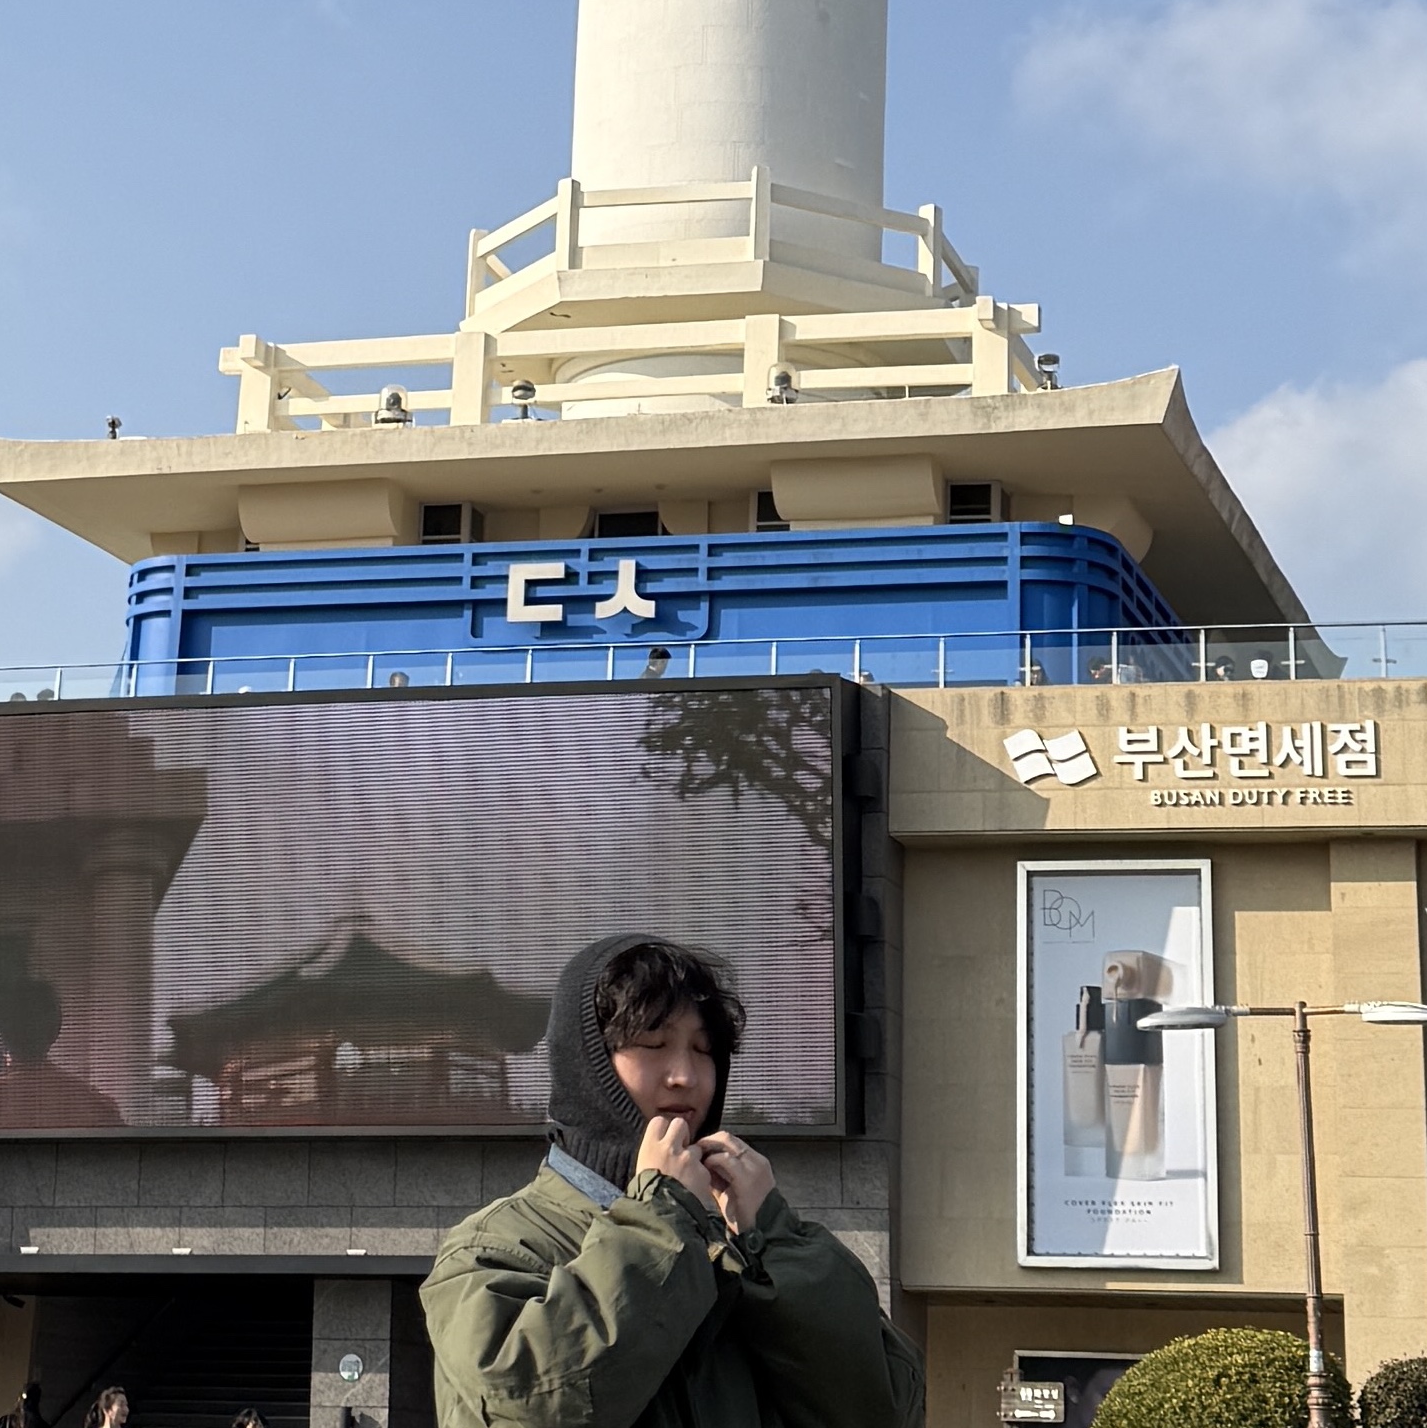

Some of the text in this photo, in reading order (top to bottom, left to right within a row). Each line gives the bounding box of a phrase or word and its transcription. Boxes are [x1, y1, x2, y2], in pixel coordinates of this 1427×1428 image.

[1113, 719, 1377, 780] 부산면세점
[1150, 786, 1354, 807] BUSAN DUTY FREE
